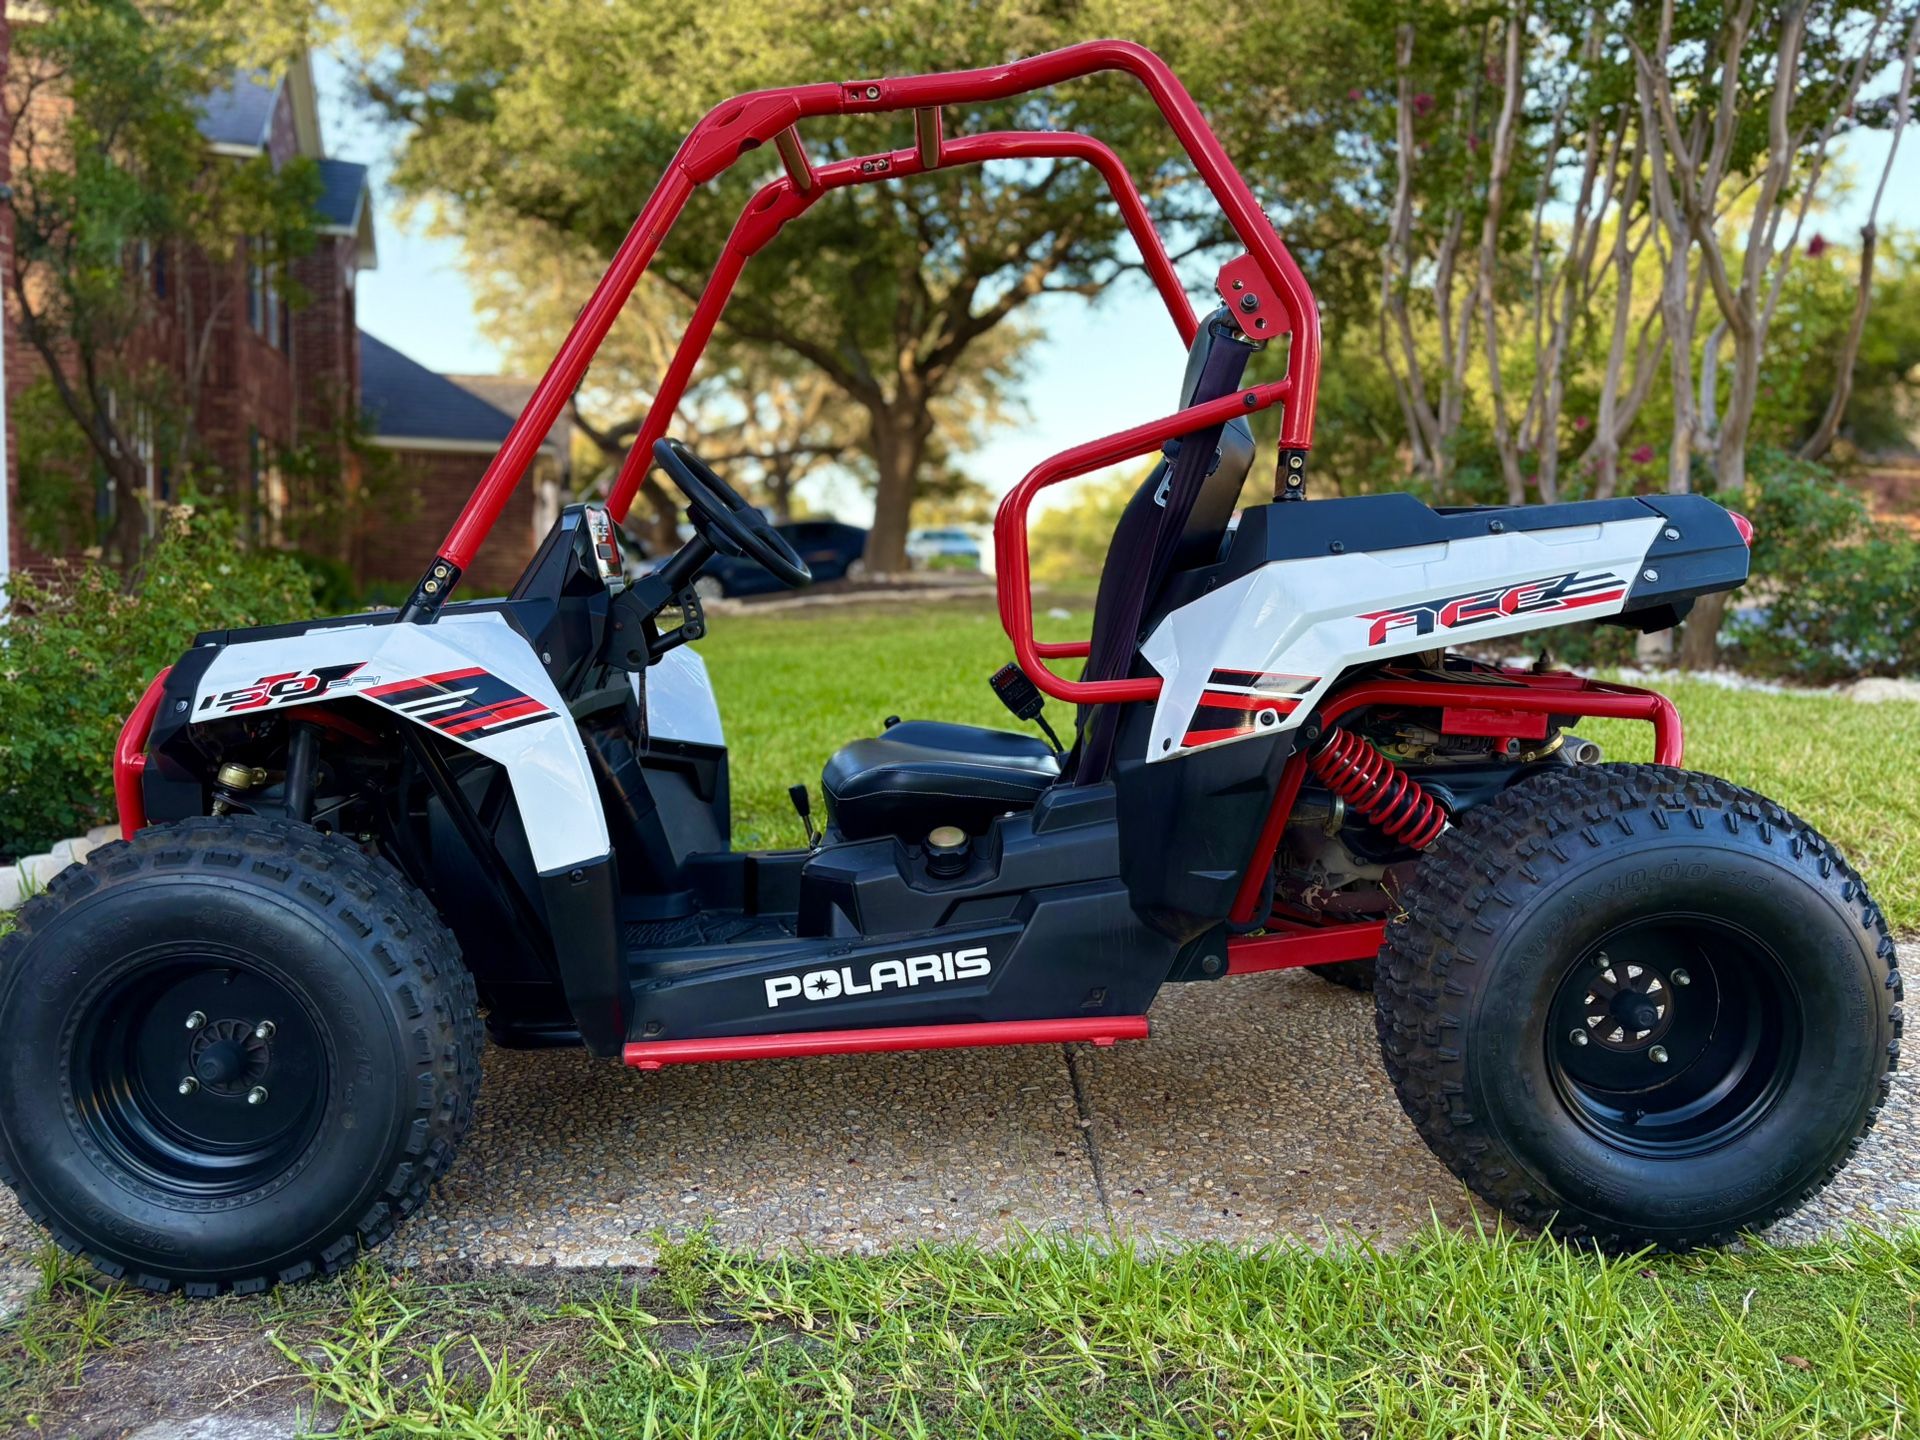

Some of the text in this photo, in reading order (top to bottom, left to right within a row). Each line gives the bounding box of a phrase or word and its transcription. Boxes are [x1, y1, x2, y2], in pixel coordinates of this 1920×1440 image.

[1364, 570, 1590, 647] ACE
[198, 662, 345, 713] 150
[764, 947, 991, 1008] POLARIS
